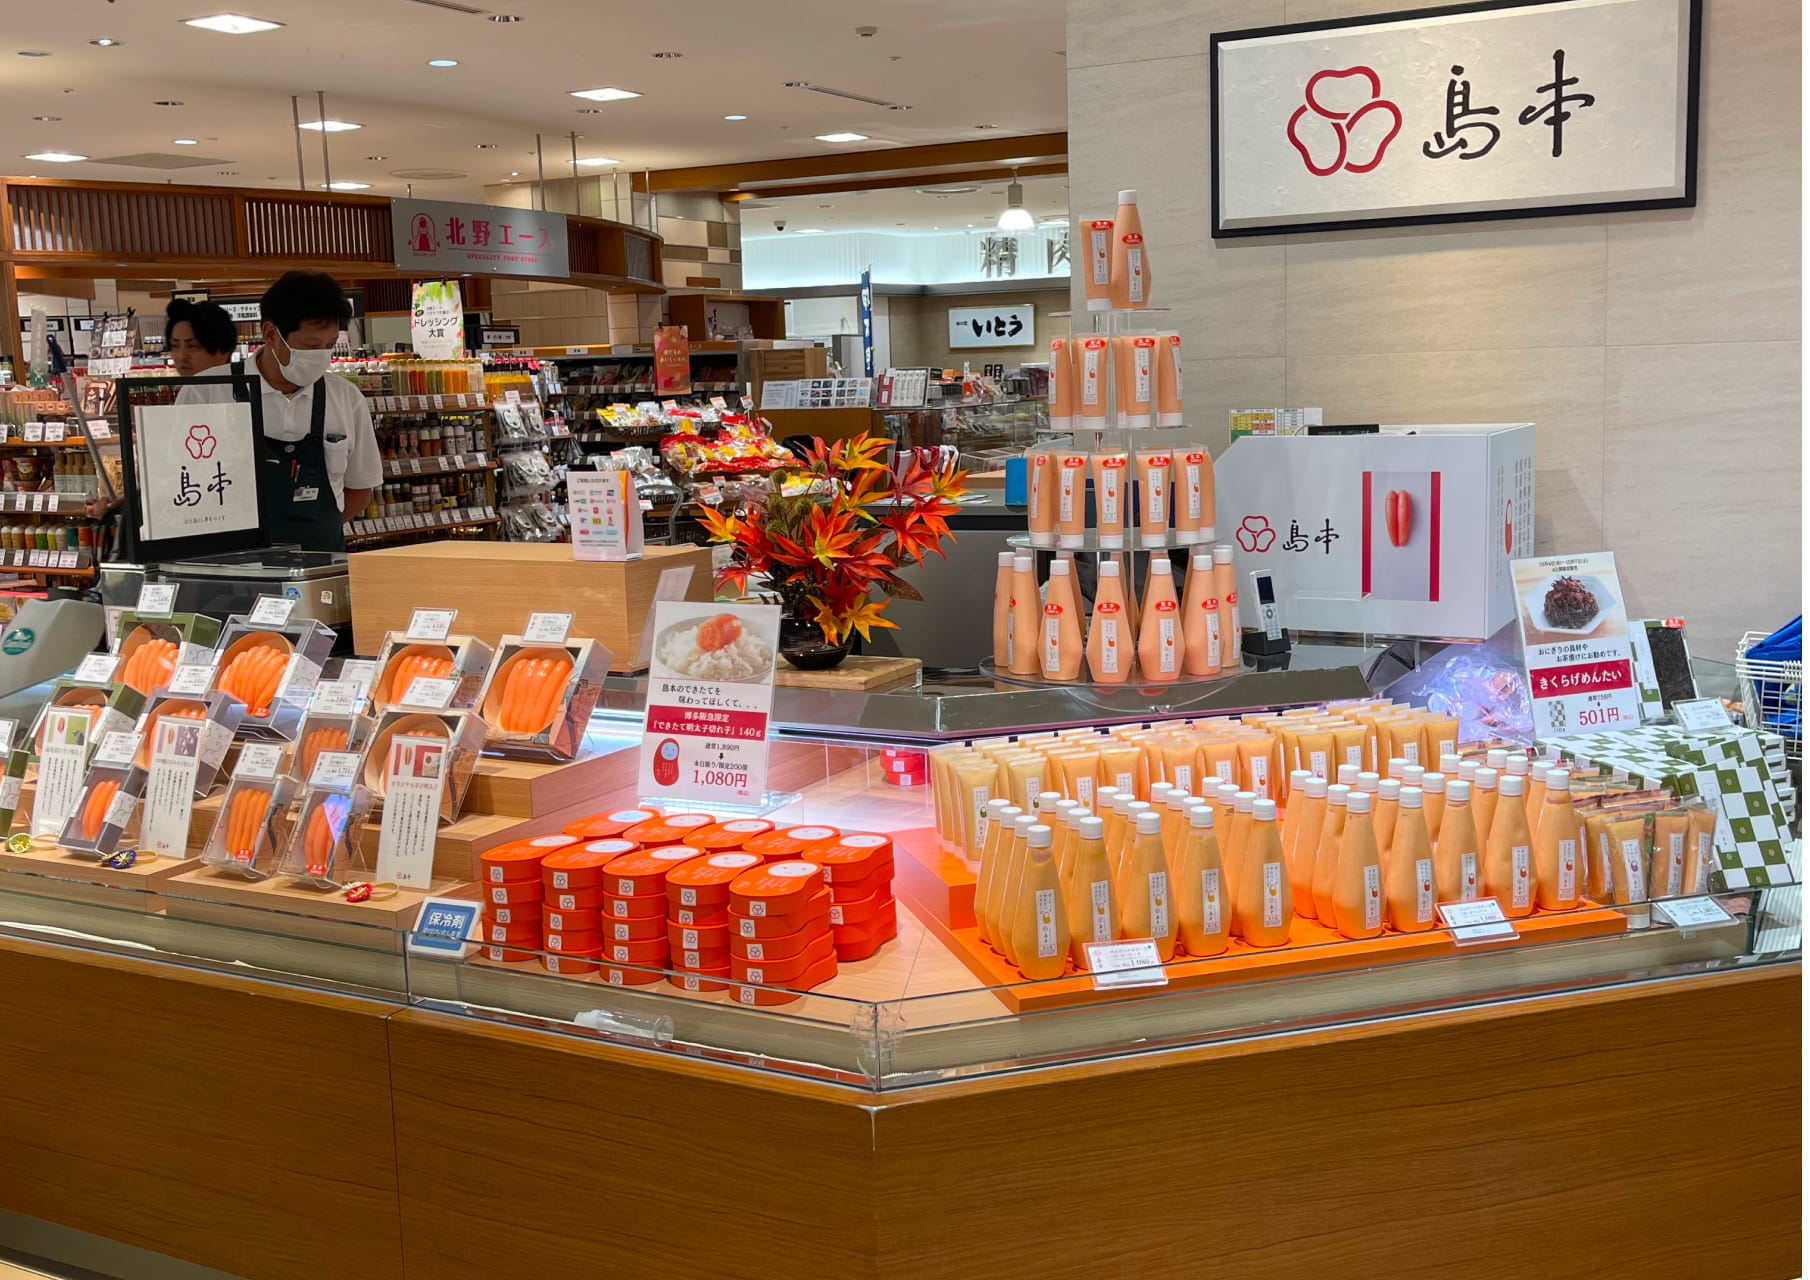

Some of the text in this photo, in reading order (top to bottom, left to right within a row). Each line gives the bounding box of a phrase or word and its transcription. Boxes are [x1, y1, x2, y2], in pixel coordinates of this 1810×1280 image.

[1422, 48, 1596, 160] 島本
[444, 216, 554, 249] 北野エース
[414, 317, 458, 328] ドレッシング
[971, 314, 1023, 338] いとう
[428, 328, 445, 338] 大賞
[173, 461, 232, 507] 島本
[1282, 518, 1339, 554] 島本
[1538, 643, 1588, 656] おにぎりの具材や
[1556, 649, 1621, 663] お茶漬けにお勧めです。
[1539, 669, 1623, 690] きくらげめんたい
[661, 683, 721, 696] 島本のできたてを
[684, 711, 730, 723] 博多阪急限定
[1579, 706, 1620, 726] 501円
[692, 769, 748, 788] 1,080円
[428, 911, 466, 929] 保冷剤
